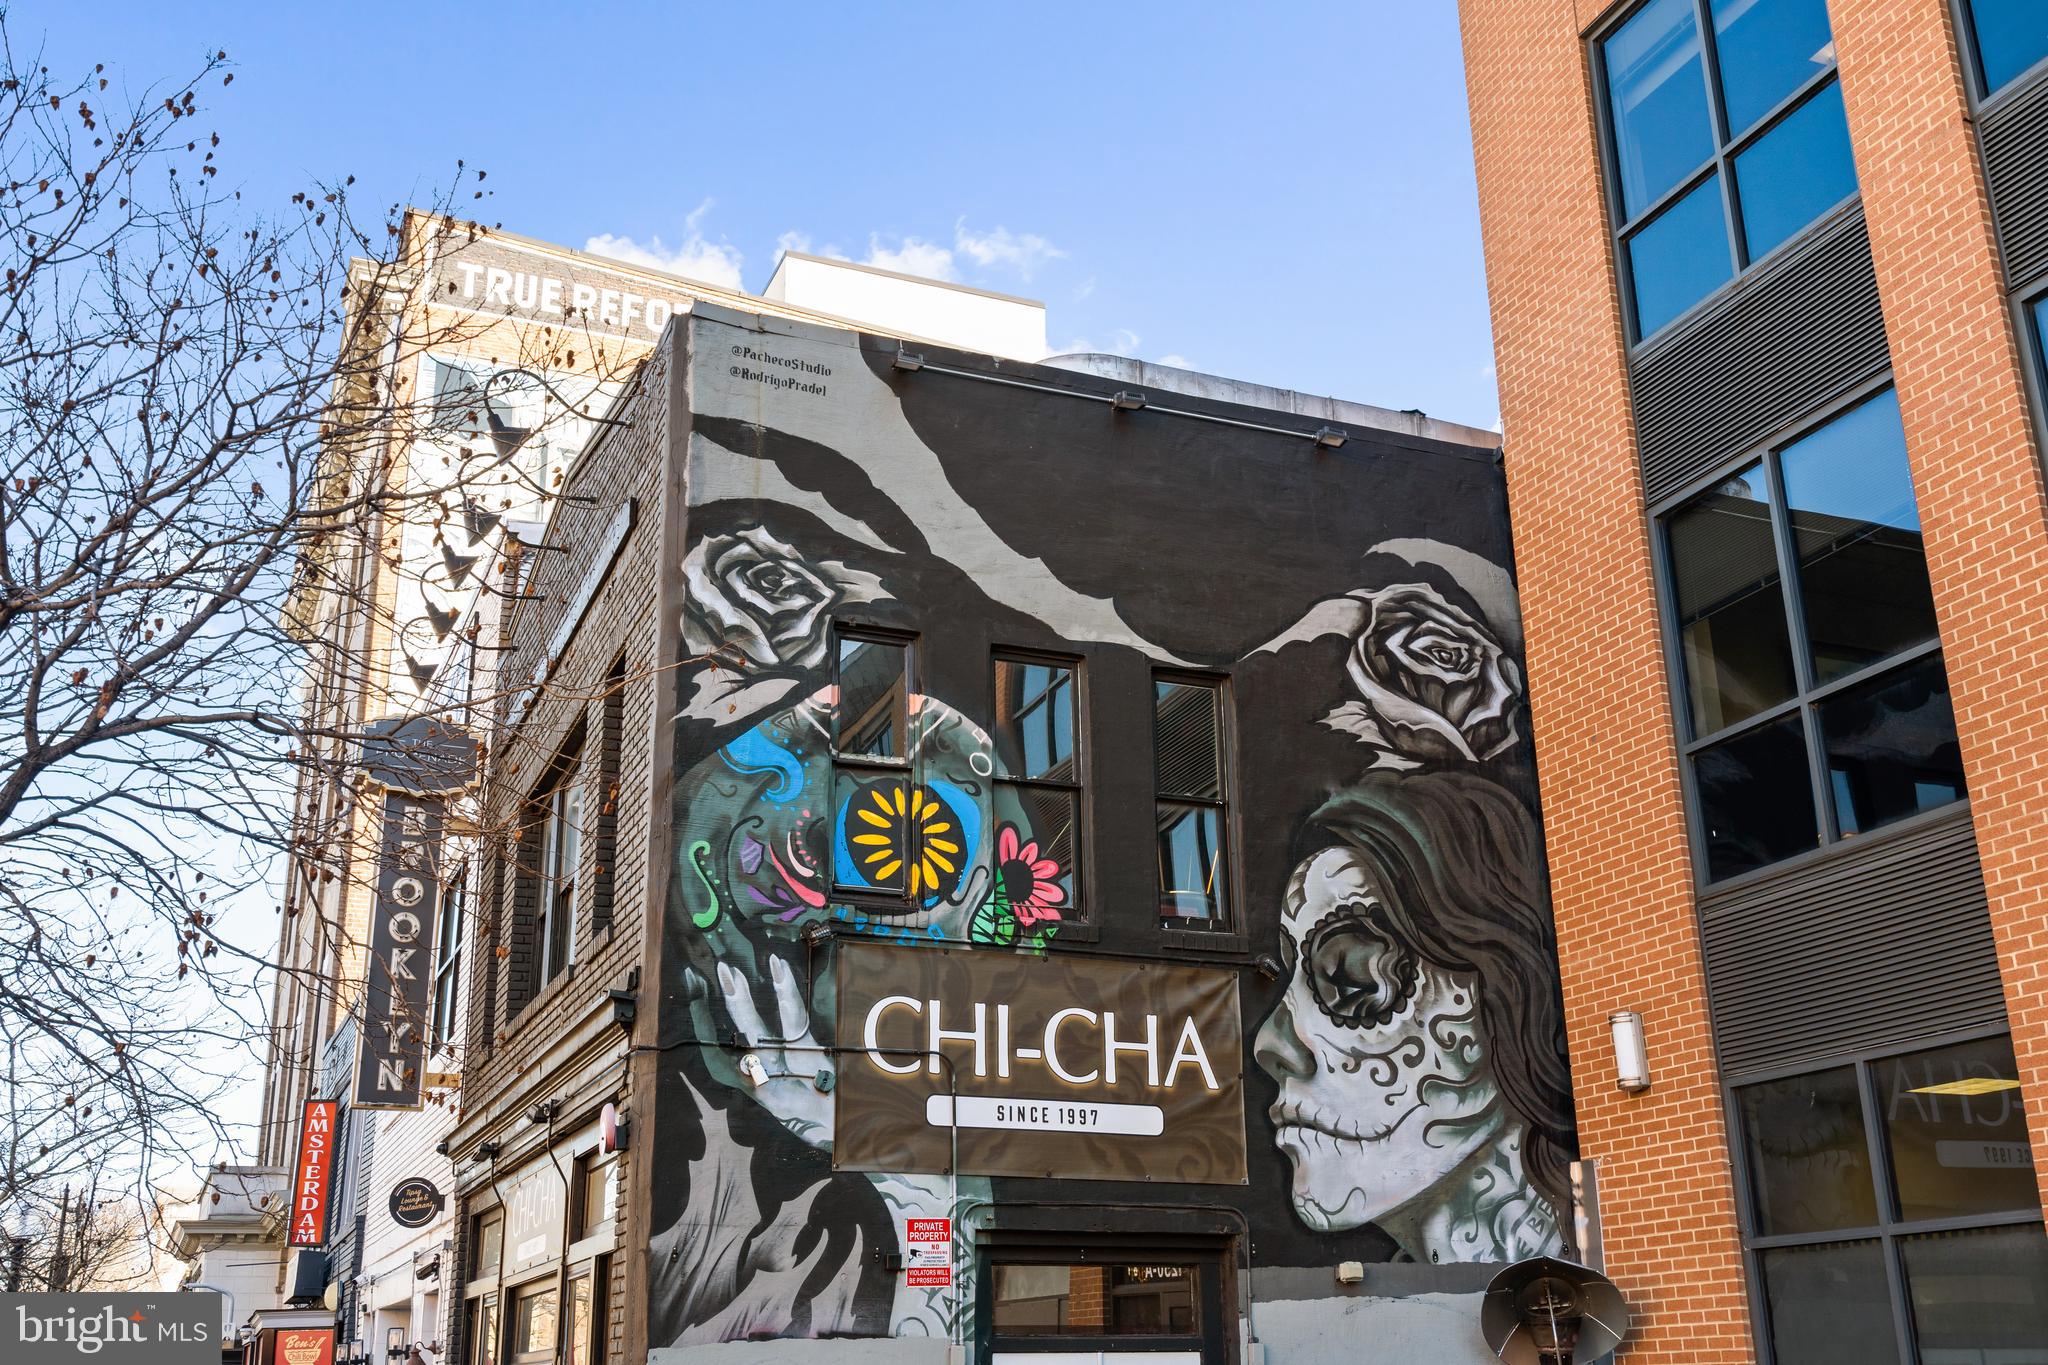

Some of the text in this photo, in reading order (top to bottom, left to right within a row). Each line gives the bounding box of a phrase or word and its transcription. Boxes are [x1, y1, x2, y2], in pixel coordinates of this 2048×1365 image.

[457, 262, 563, 315] TRUE
[731, 345, 832, 376] @PachecoStudio
[729, 366, 827, 396] @RodrigoPradel
[377, 805, 428, 1092] BROOKLYN
[864, 995, 1220, 1091] CHI-CHA
[996, 1105, 1099, 1127] SINCE 1997
[296, 1103, 328, 1243] AMSTERDAM
[513, 1174, 557, 1238] CHI-CHA
[909, 1231, 949, 1241] PROPERTY
[914, 1222, 944, 1231] PRIVATE
[285, 1334, 316, 1349] Ben's
